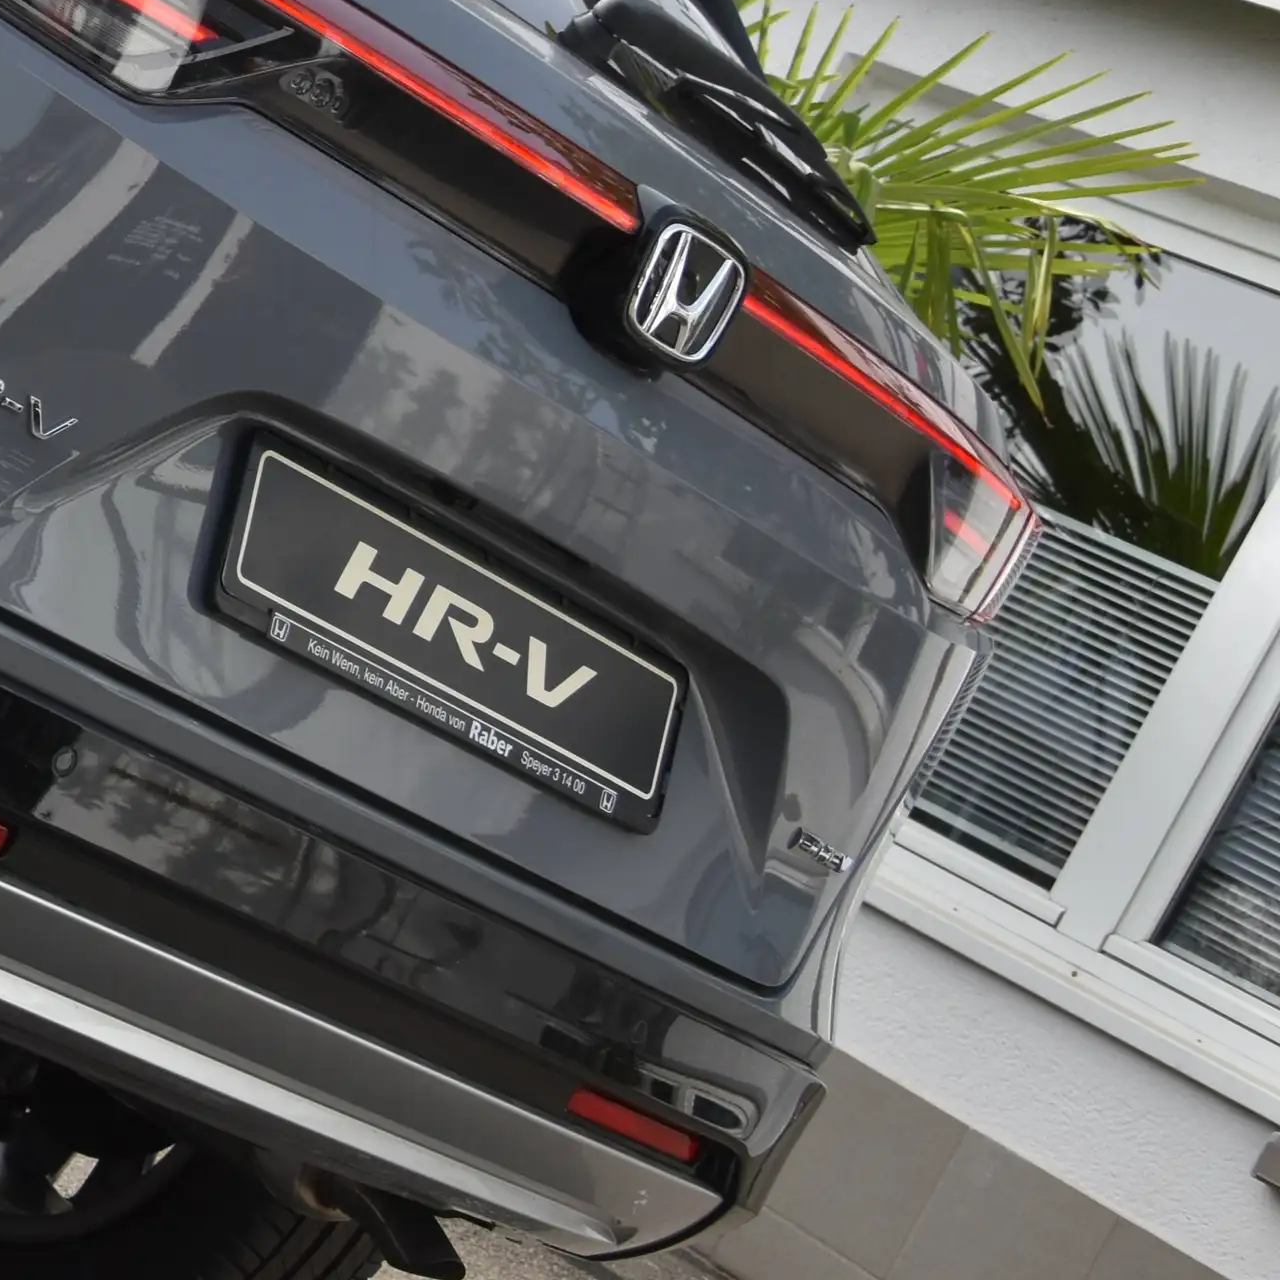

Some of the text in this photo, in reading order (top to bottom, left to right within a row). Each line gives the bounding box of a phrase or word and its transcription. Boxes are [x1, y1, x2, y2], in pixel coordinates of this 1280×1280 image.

[334, 541, 598, 708] HR-V
[307, 639, 330, 661] Kein
[332, 650, 361, 679] Wenn,
[364, 667, 384, 689] kein
[385, 680, 409, 701] Aber
[416, 695, 447, 721] Honda
[448, 714, 465, 732] von
[469, 720, 513, 758] Raber
[521, 750, 552, 775] Speyer
[552, 768, 560, 781] 3
[561, 772, 572, 788] 14
[573, 779, 586, 795] 00
